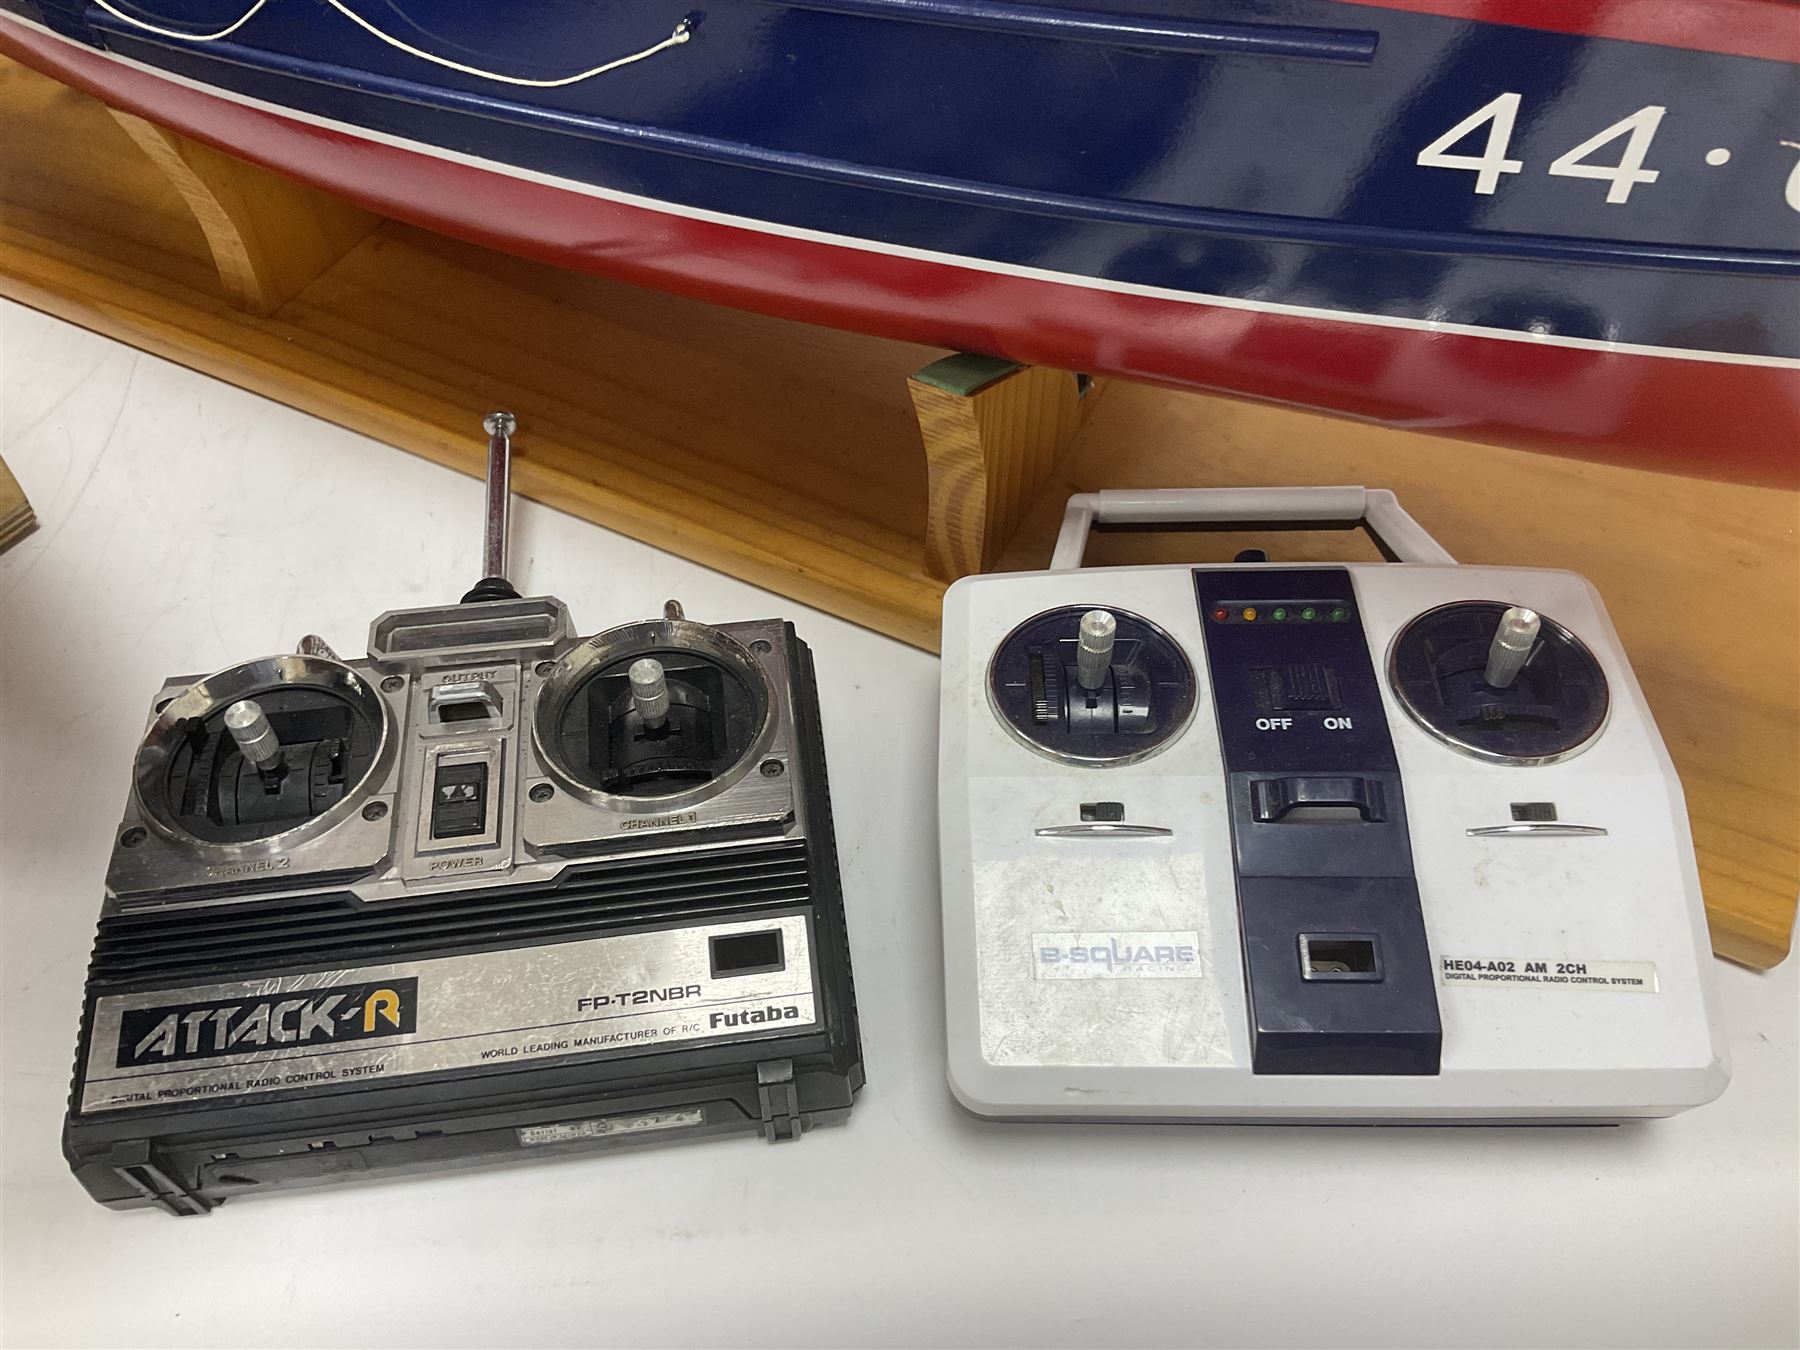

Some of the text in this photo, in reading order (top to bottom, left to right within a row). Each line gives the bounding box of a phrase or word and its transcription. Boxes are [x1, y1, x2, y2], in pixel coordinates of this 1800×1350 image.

[442, 670, 498, 683] OUTPUT
[1255, 717, 1353, 730] OFF ON
[620, 811, 697, 830] CHANNEL 1
[277, 856, 289, 868] 2
[430, 857, 483, 871] POWER
[1443, 959, 1587, 974] HE04-A02 AM 2CH
[1445, 973, 1643, 986] DIGITAL PROPORTIONAL RADIO CONTROL SYSTEM
[134, 988, 401, 1060] ATTACK-R
[709, 1005, 799, 1029] Futaba
[481, 1023, 700, 1060] WORLD LEADING MANUFACTURER OF R/C
[111, 1064, 385, 1105] DIGITAL PROPORTIONAL RADIO CONTROL SYSTEM
